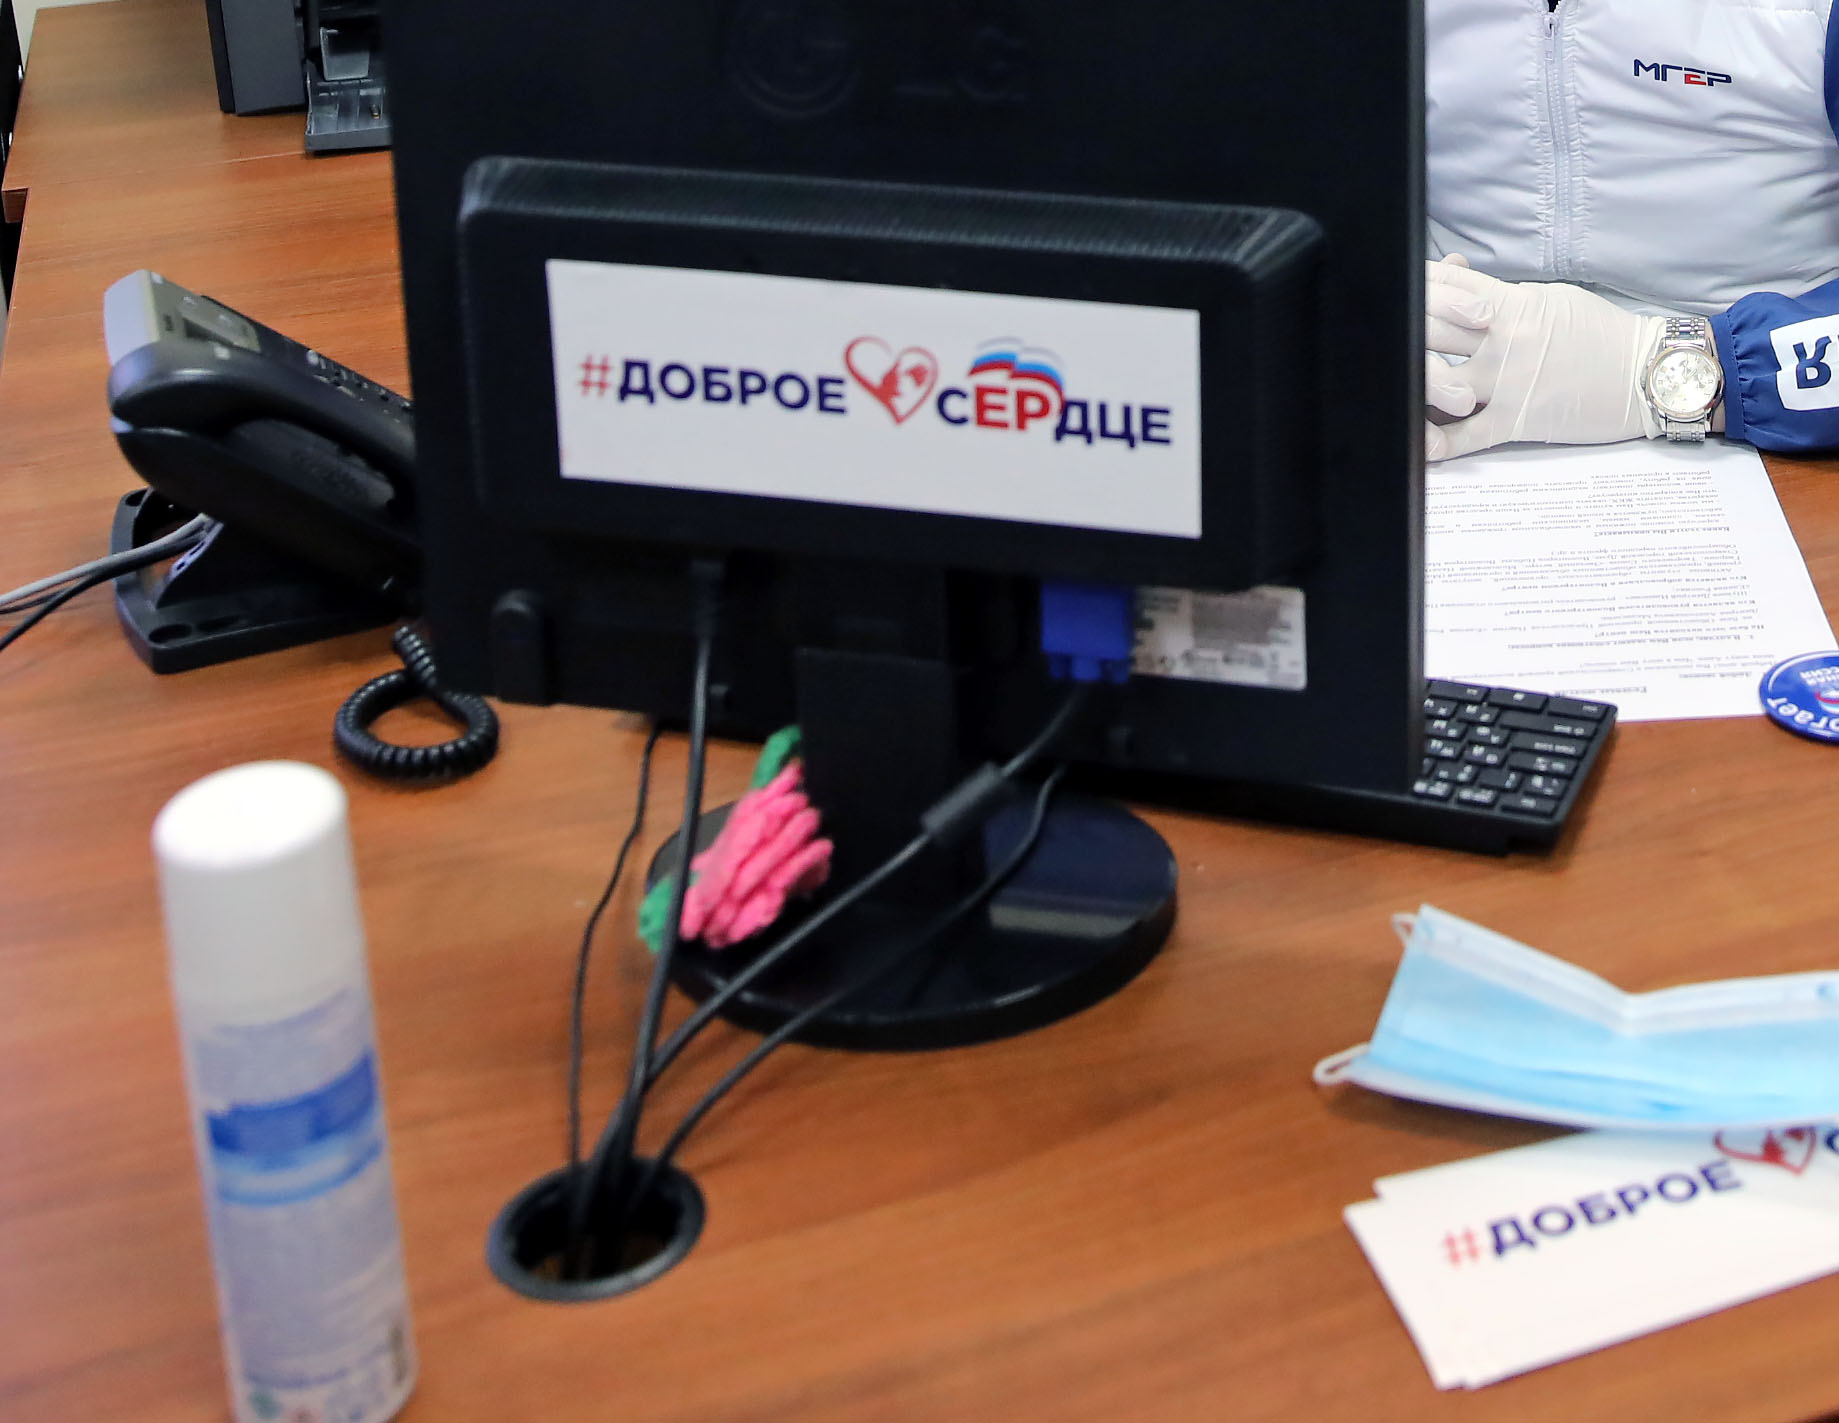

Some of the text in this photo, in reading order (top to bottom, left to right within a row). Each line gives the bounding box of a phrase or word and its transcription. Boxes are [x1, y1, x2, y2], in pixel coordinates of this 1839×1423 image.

[1633, 58, 1733, 87] МГЕР
[578, 353, 1173, 450] #ДОБРОЕ СЕРДЦЕ
[1441, 1158, 1744, 1266] #ДОБРОЕ
